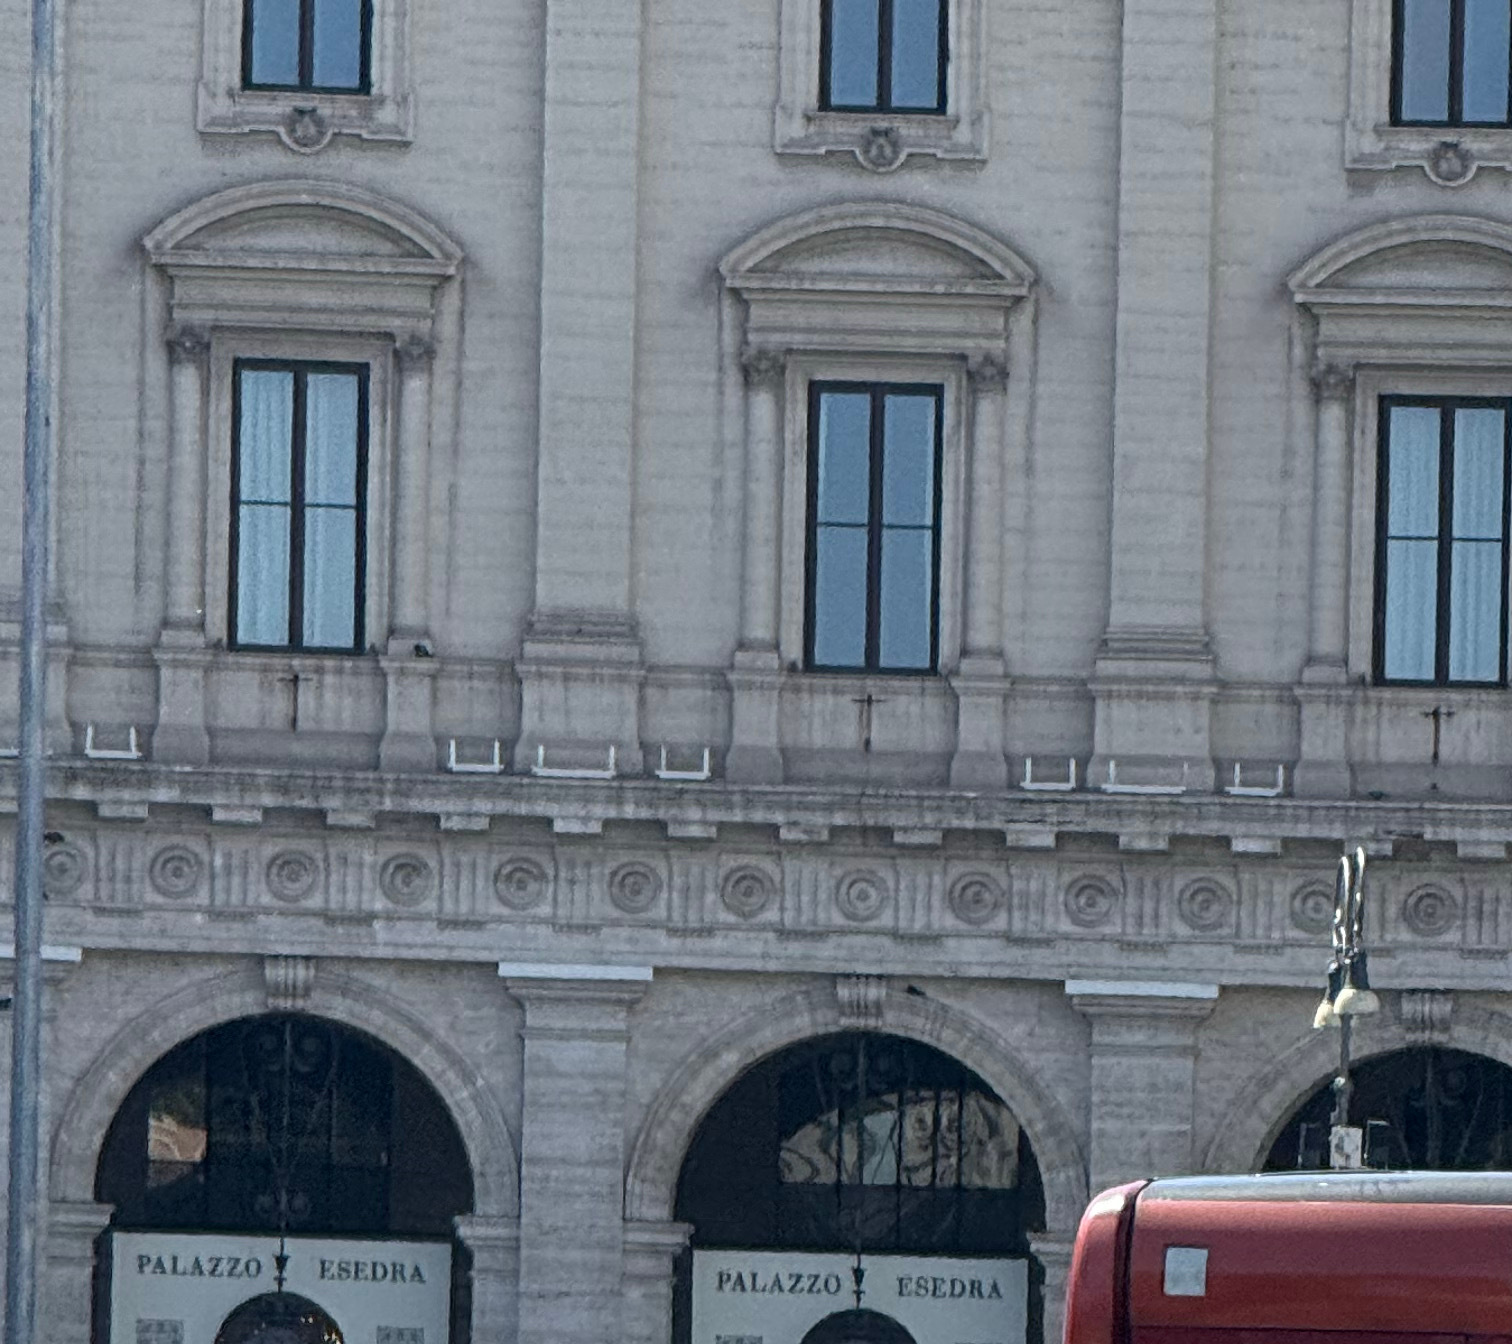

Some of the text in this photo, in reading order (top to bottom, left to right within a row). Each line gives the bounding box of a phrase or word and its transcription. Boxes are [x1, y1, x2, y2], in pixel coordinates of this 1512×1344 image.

[137, 1254, 426, 1284] PALAZZO ESEDRA
[717, 1271, 1002, 1300] PALAZZO ESEDRA
